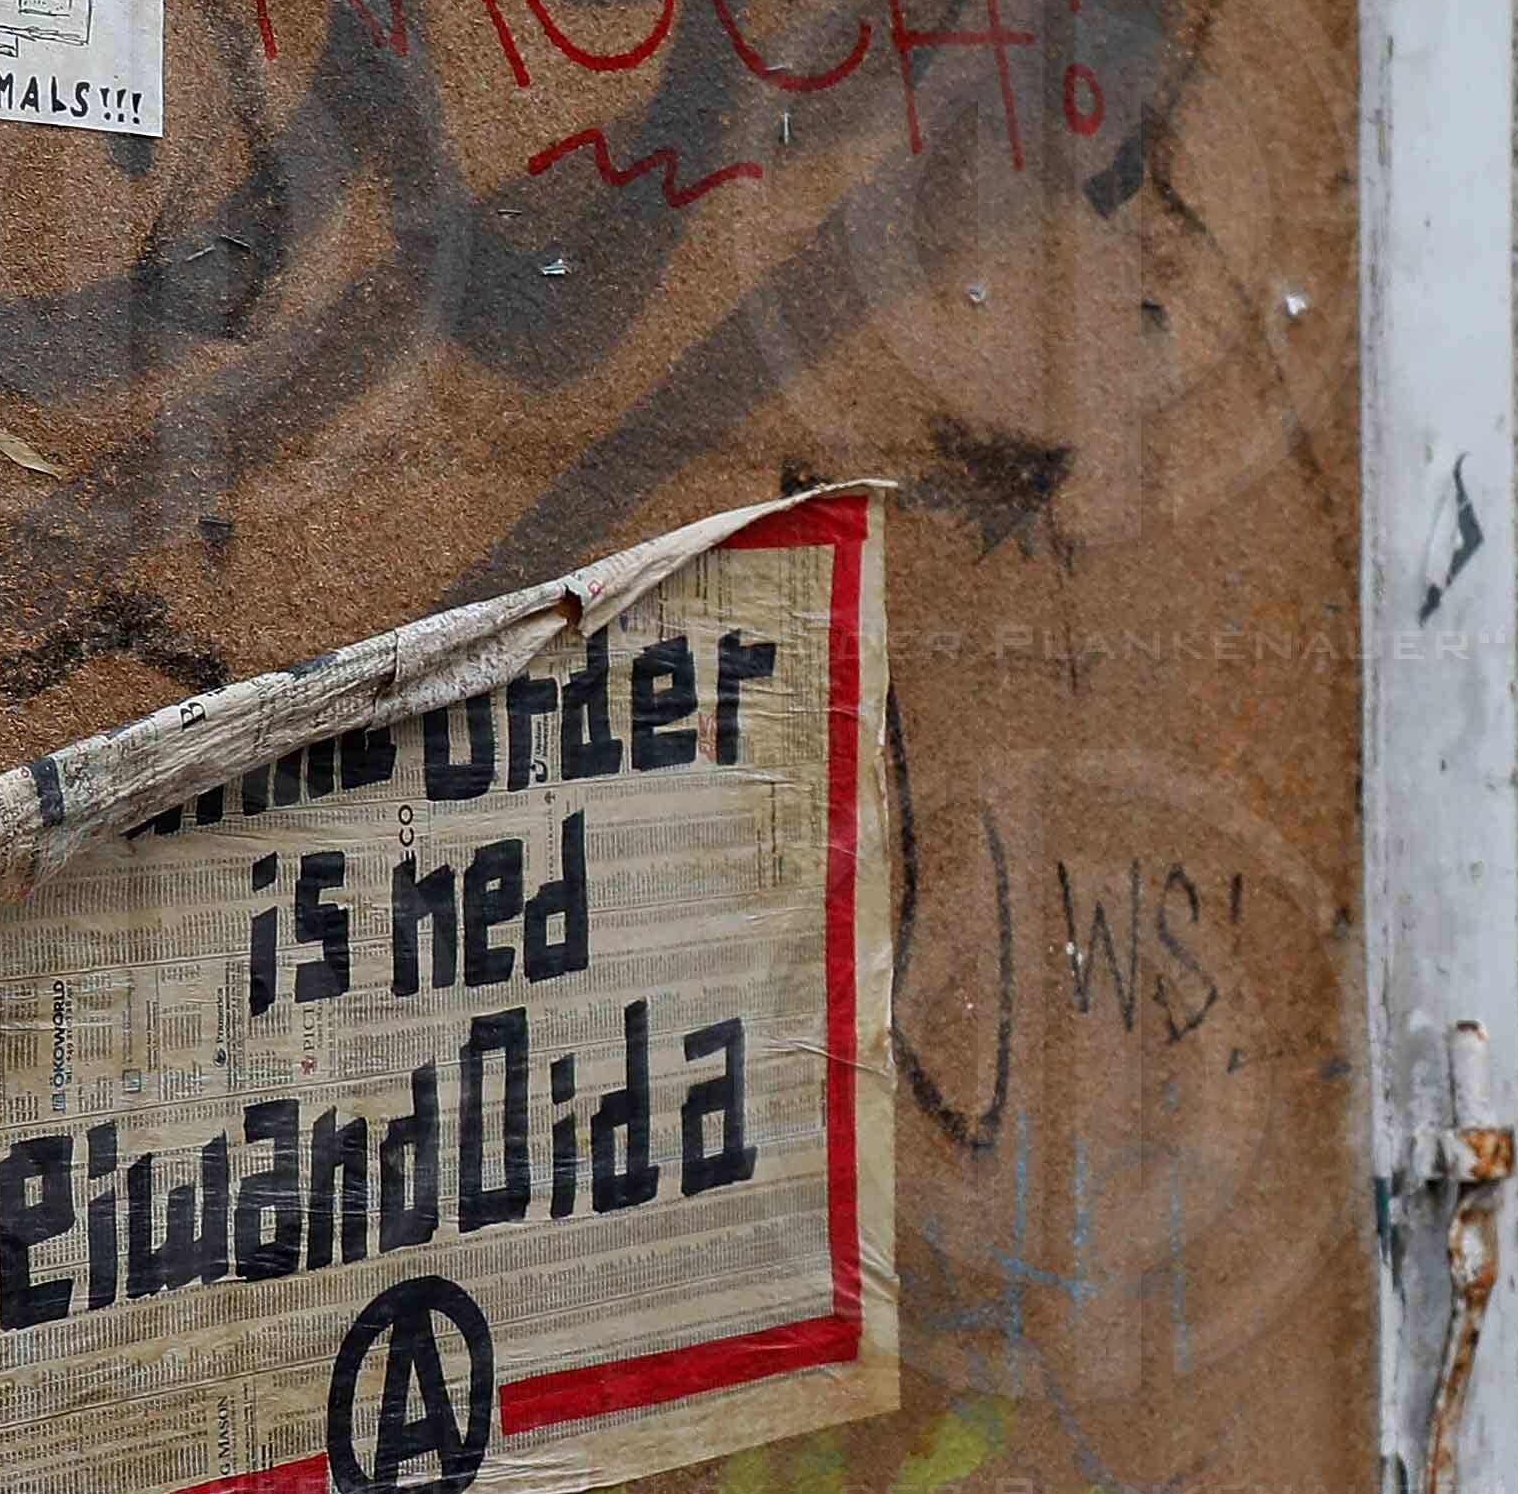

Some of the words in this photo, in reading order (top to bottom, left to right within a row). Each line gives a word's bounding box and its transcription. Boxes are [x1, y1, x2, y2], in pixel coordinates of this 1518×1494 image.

[250, 849, 349, 1017] is
[392, 812, 587, 997] ned
[50, 980, 67, 1089] ÖKOWORLD
